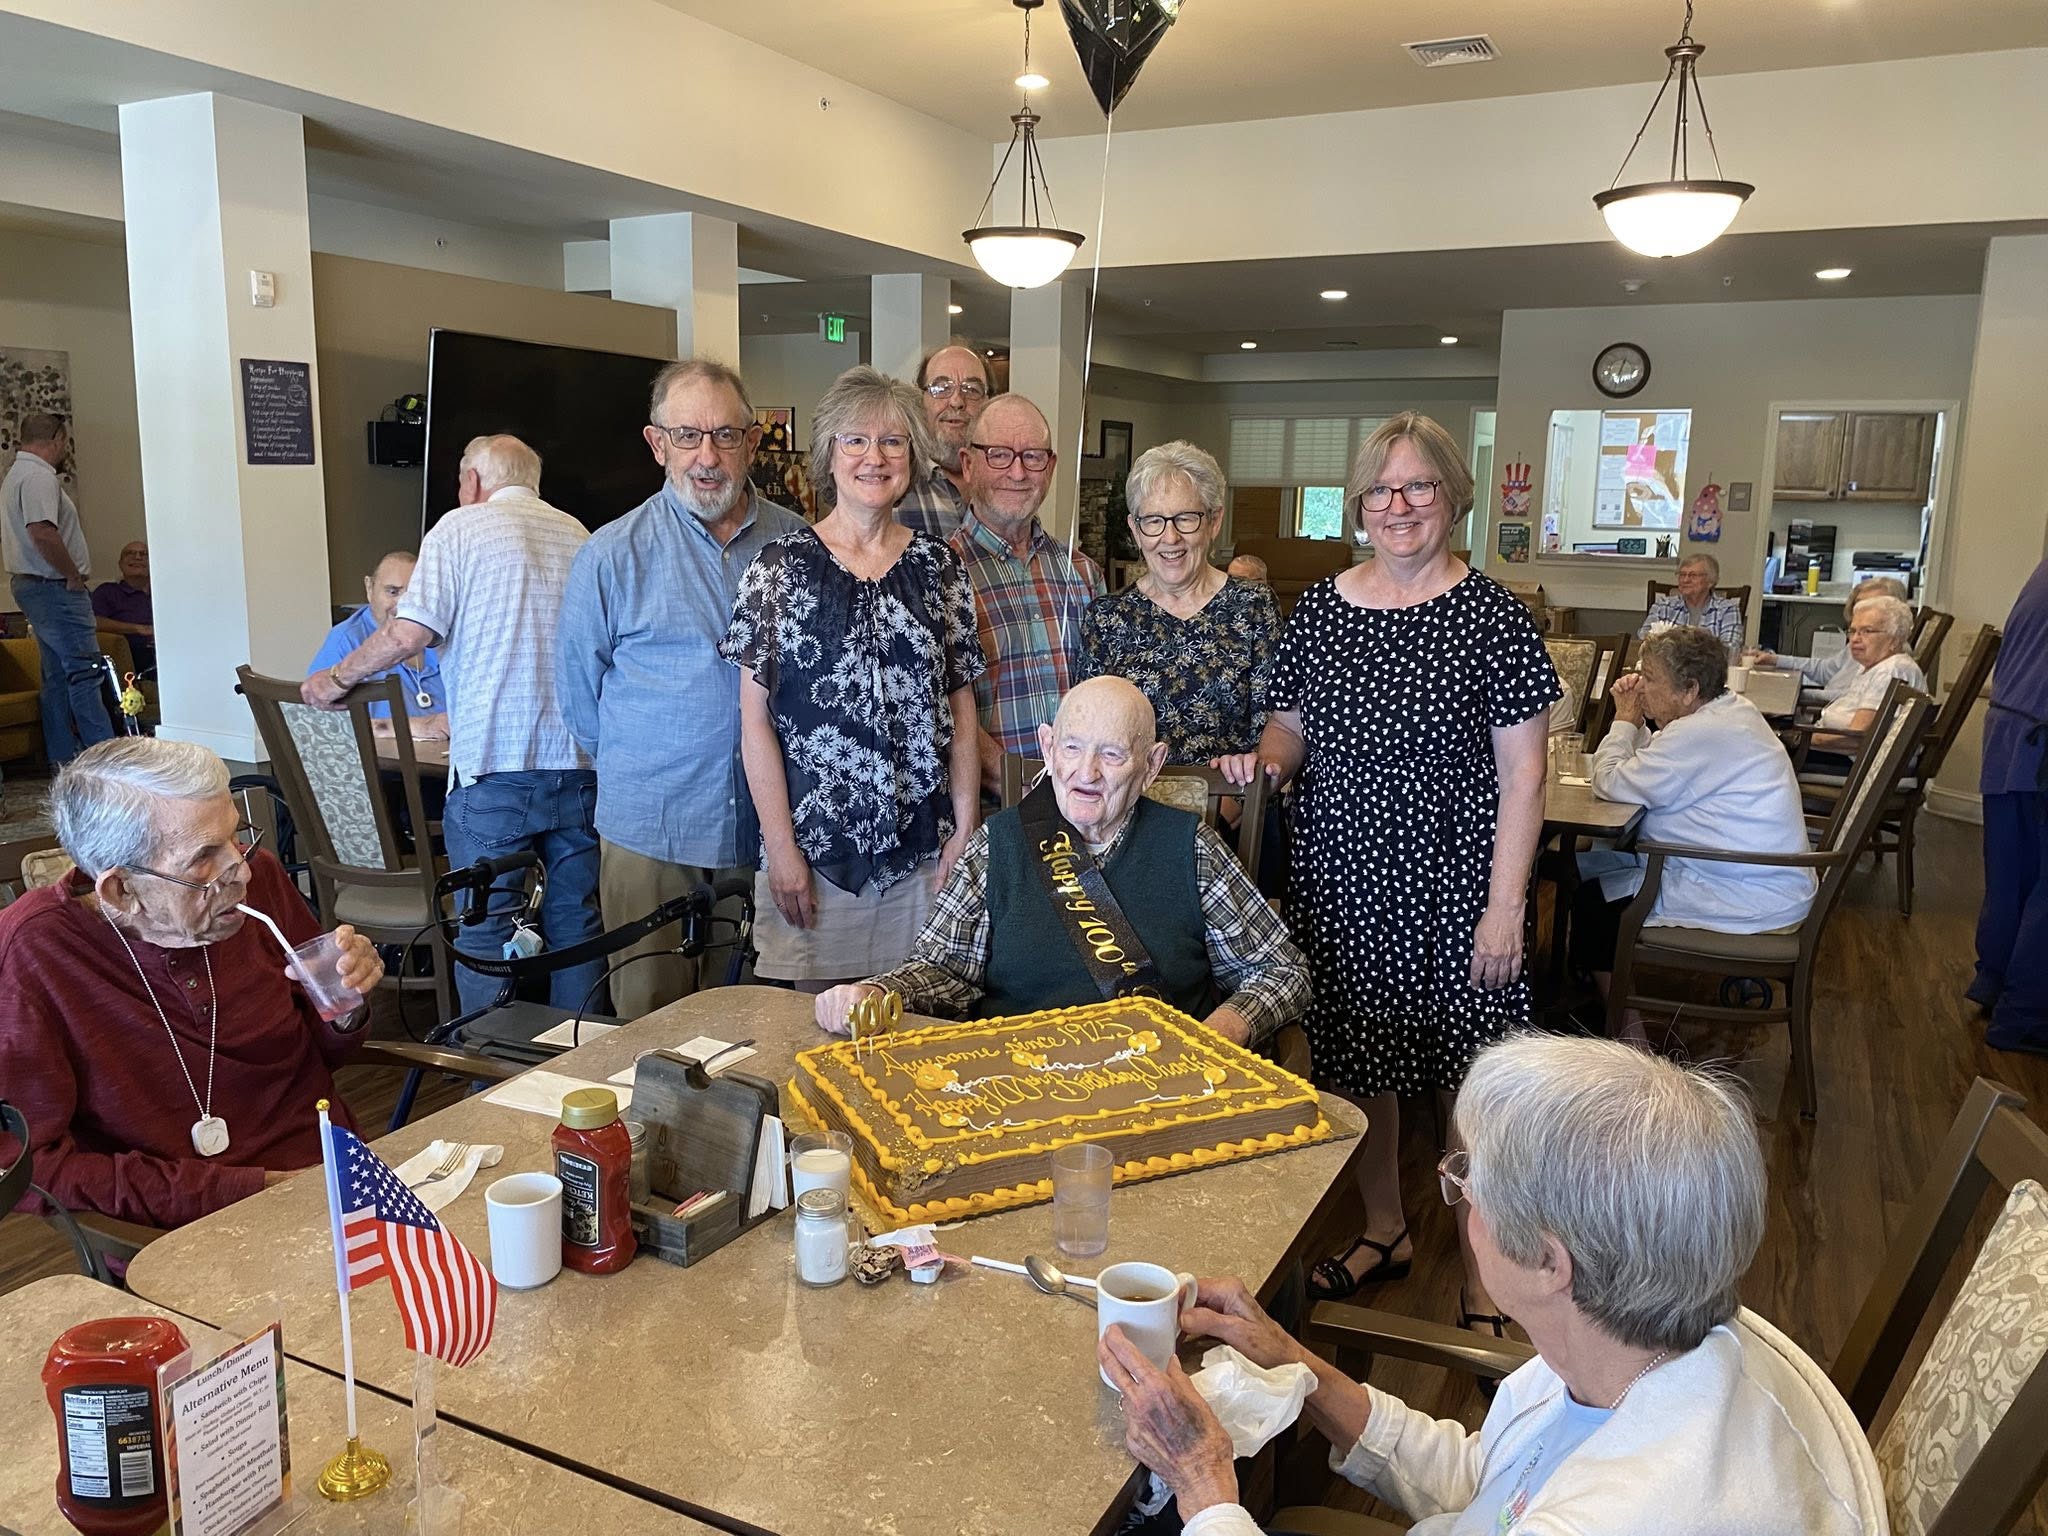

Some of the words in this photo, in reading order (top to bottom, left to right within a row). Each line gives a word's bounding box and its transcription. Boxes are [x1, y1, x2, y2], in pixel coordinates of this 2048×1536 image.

[828, 317, 845, 342] EXIT
[1039, 831, 1096, 911] Happy
[1057, 1018, 1134, 1045] 1925
[904, 1088, 1002, 1117] Happy
[182, 1375, 238, 1417] Alternative
[240, 1355, 269, 1379] Menu
[197, 1348, 253, 1387] Lunch/Dinner
[87, 1396, 103, 1405] Facts
[200, 1397, 232, 1421] Sandwich
[233, 1387, 248, 1398] with
[248, 1374, 267, 1389] Chips
[97, 1421, 104, 1430] 20
[200, 1434, 219, 1452] Salad
[219, 1426, 235, 1438] with
[235, 1410, 257, 1428] Dinner
[258, 1400, 271, 1413] Roll
[227, 1440, 248, 1457] Soups
[200, 1475, 230, 1501] Spaghetti
[231, 1465, 246, 1478] with
[247, 1443, 277, 1467] Meatballs
[205, 1479, 241, 1510] Hamburger
[243, 1470, 257, 1483] with
[257, 1458, 273, 1472] Fries
